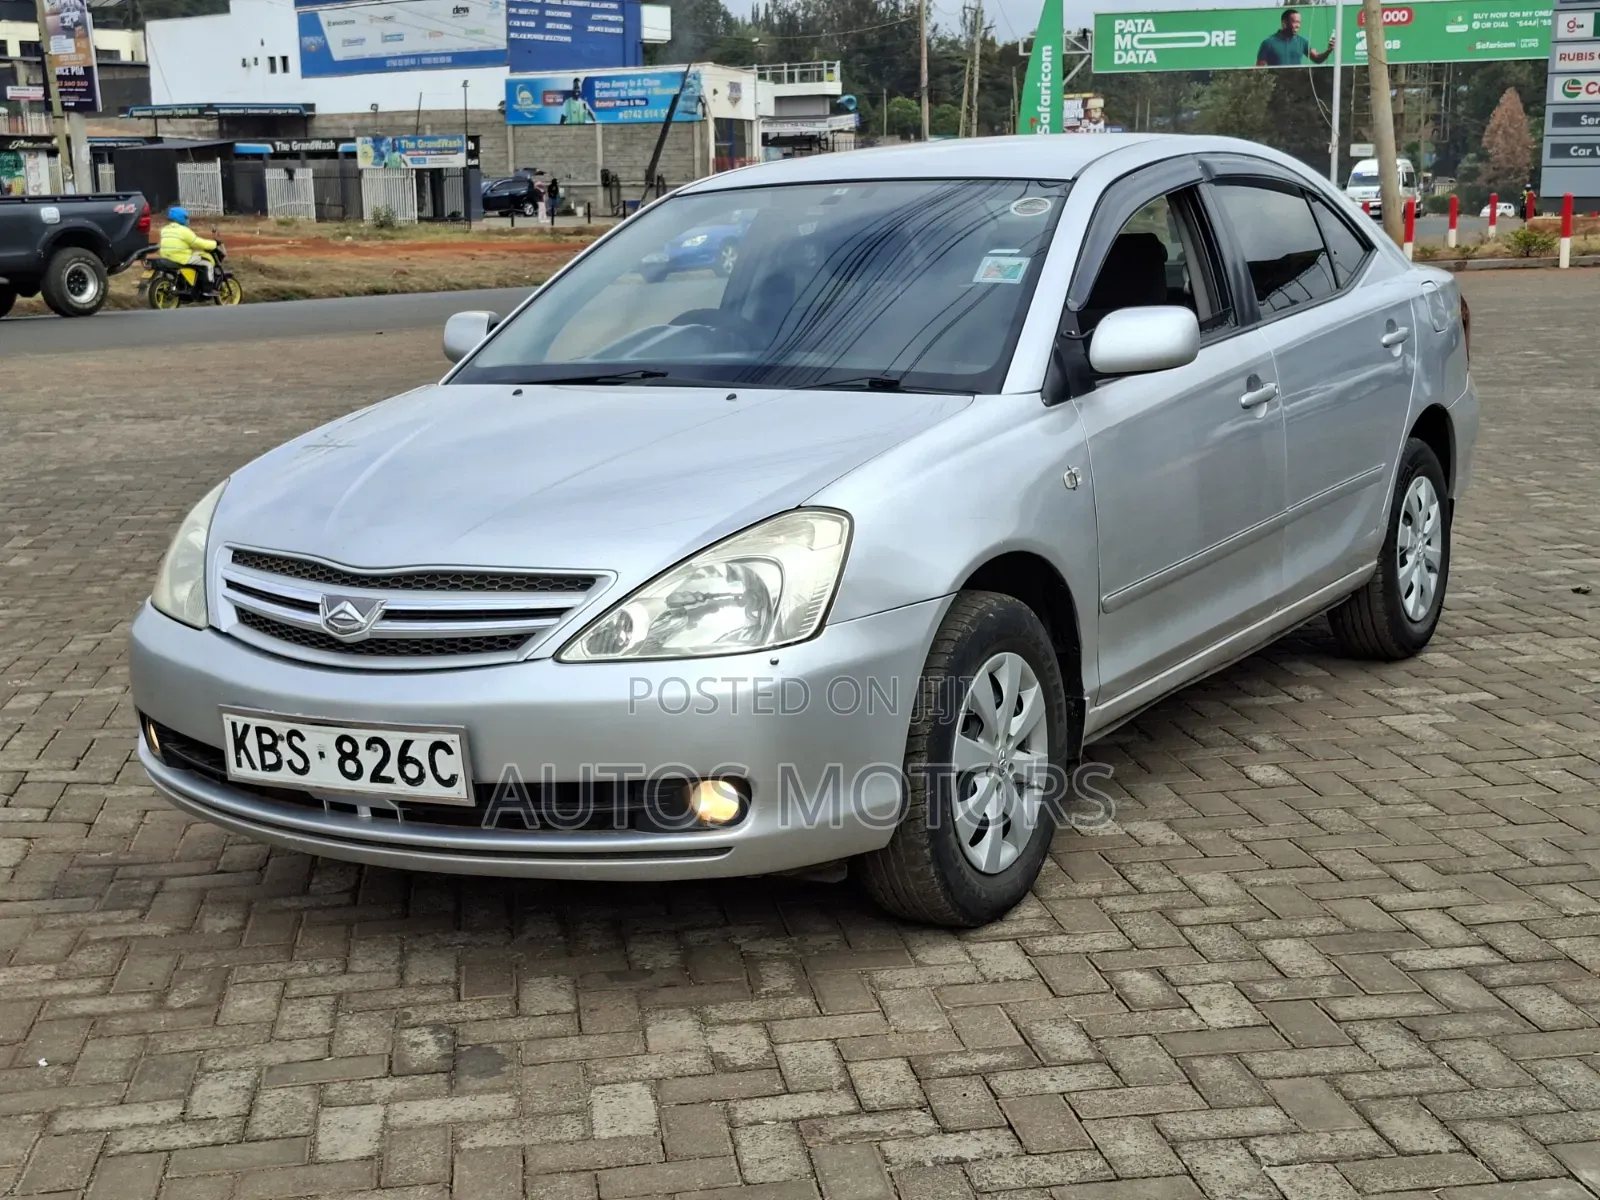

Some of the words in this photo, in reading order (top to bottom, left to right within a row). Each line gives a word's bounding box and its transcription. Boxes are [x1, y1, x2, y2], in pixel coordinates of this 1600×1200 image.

[452, 5, 470, 15] dew
[1114, 19, 1156, 33] PATA
[1114, 30, 1237, 51] MORE
[1384, 39, 1401, 49] GB
[1475, 41, 1516, 50] Safaricom
[1114, 50, 1158, 64] DATA
[1036, 45, 1053, 135] Safaricom
[275, 142, 290, 151] The
[291, 140, 336, 151] GrandWash
[401, 139, 417, 149] The
[417, 138, 463, 149] GrandWash
[1570, 145, 1593, 156] Car
[231, 721, 311, 776] KBS
[335, 733, 460, 788] 826C
